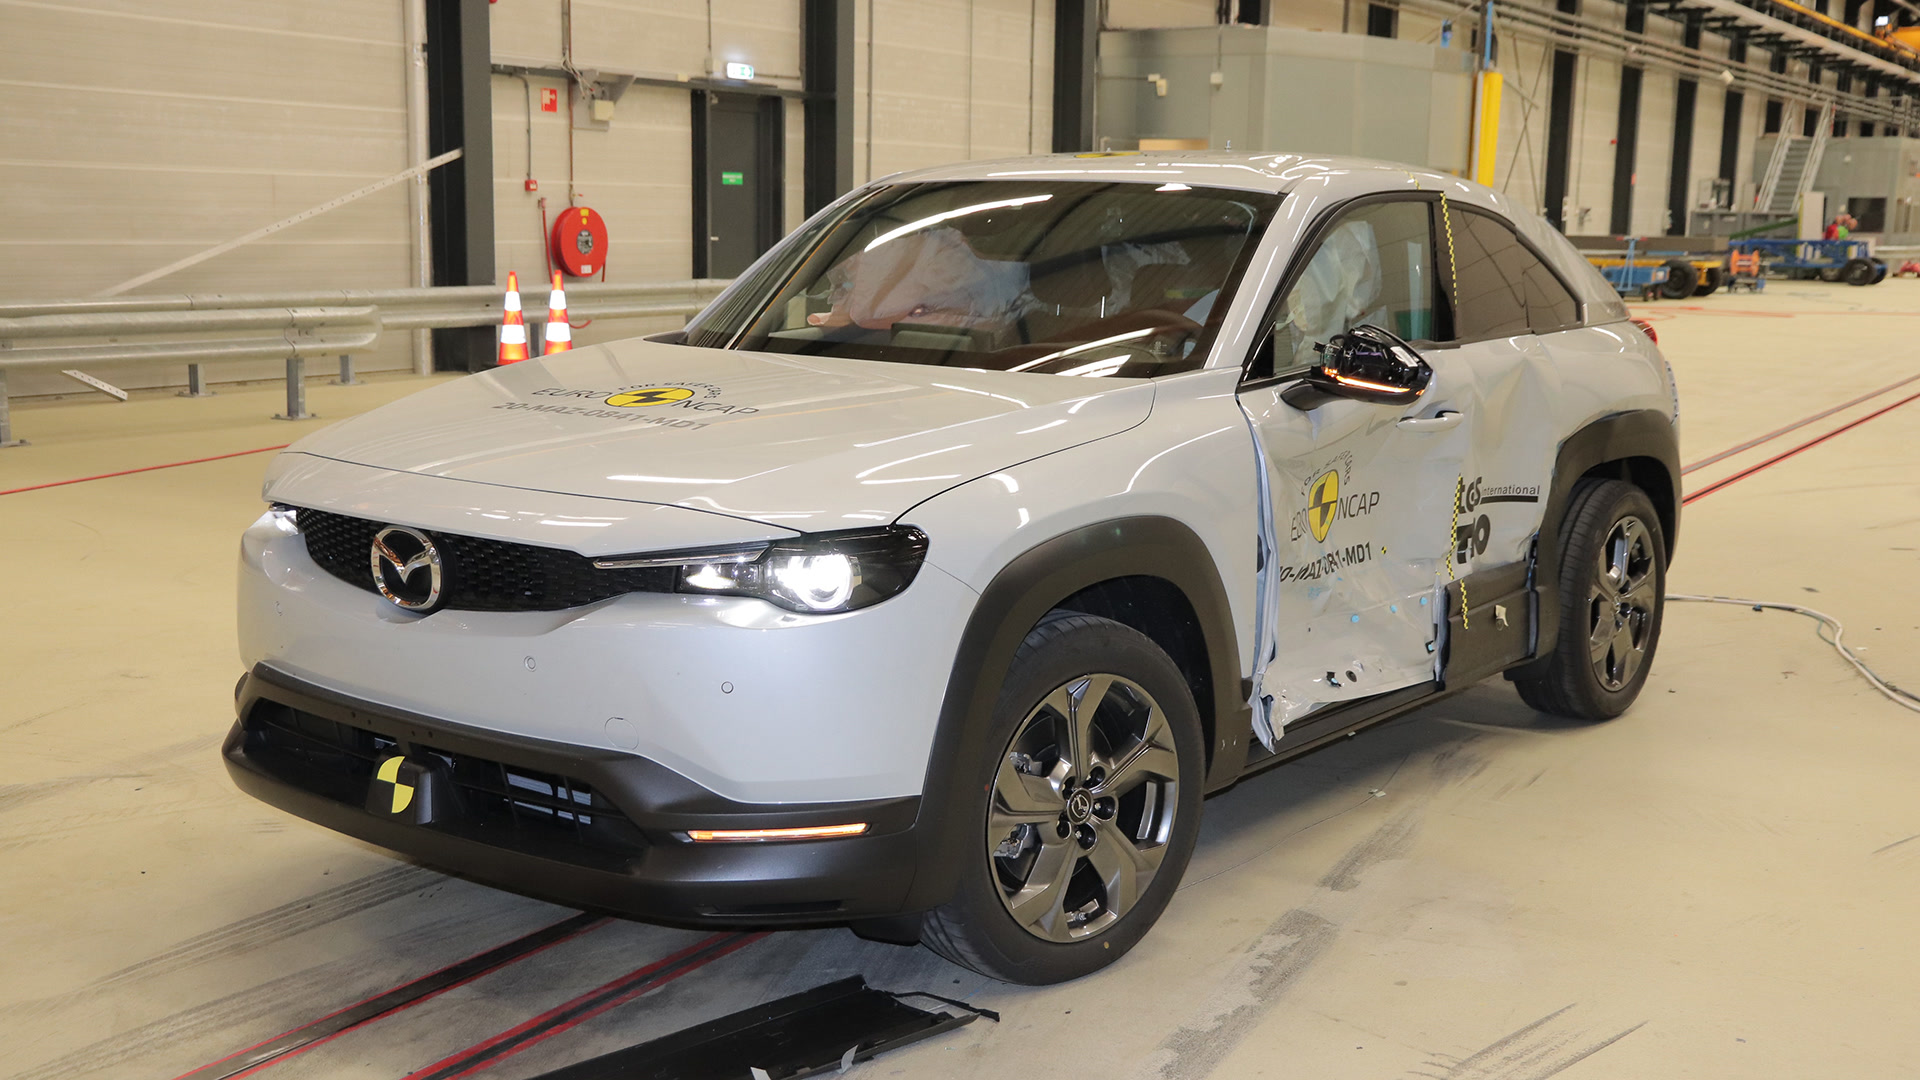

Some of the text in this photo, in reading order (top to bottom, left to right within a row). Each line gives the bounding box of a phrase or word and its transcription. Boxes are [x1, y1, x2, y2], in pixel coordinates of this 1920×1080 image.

[531, 387, 760, 415] EURO NCAP
[491, 402, 711, 431] 20-MAZ-0841-MD1
[1482, 485, 1540, 496] international
[1337, 491, 1380, 520] NCAP
